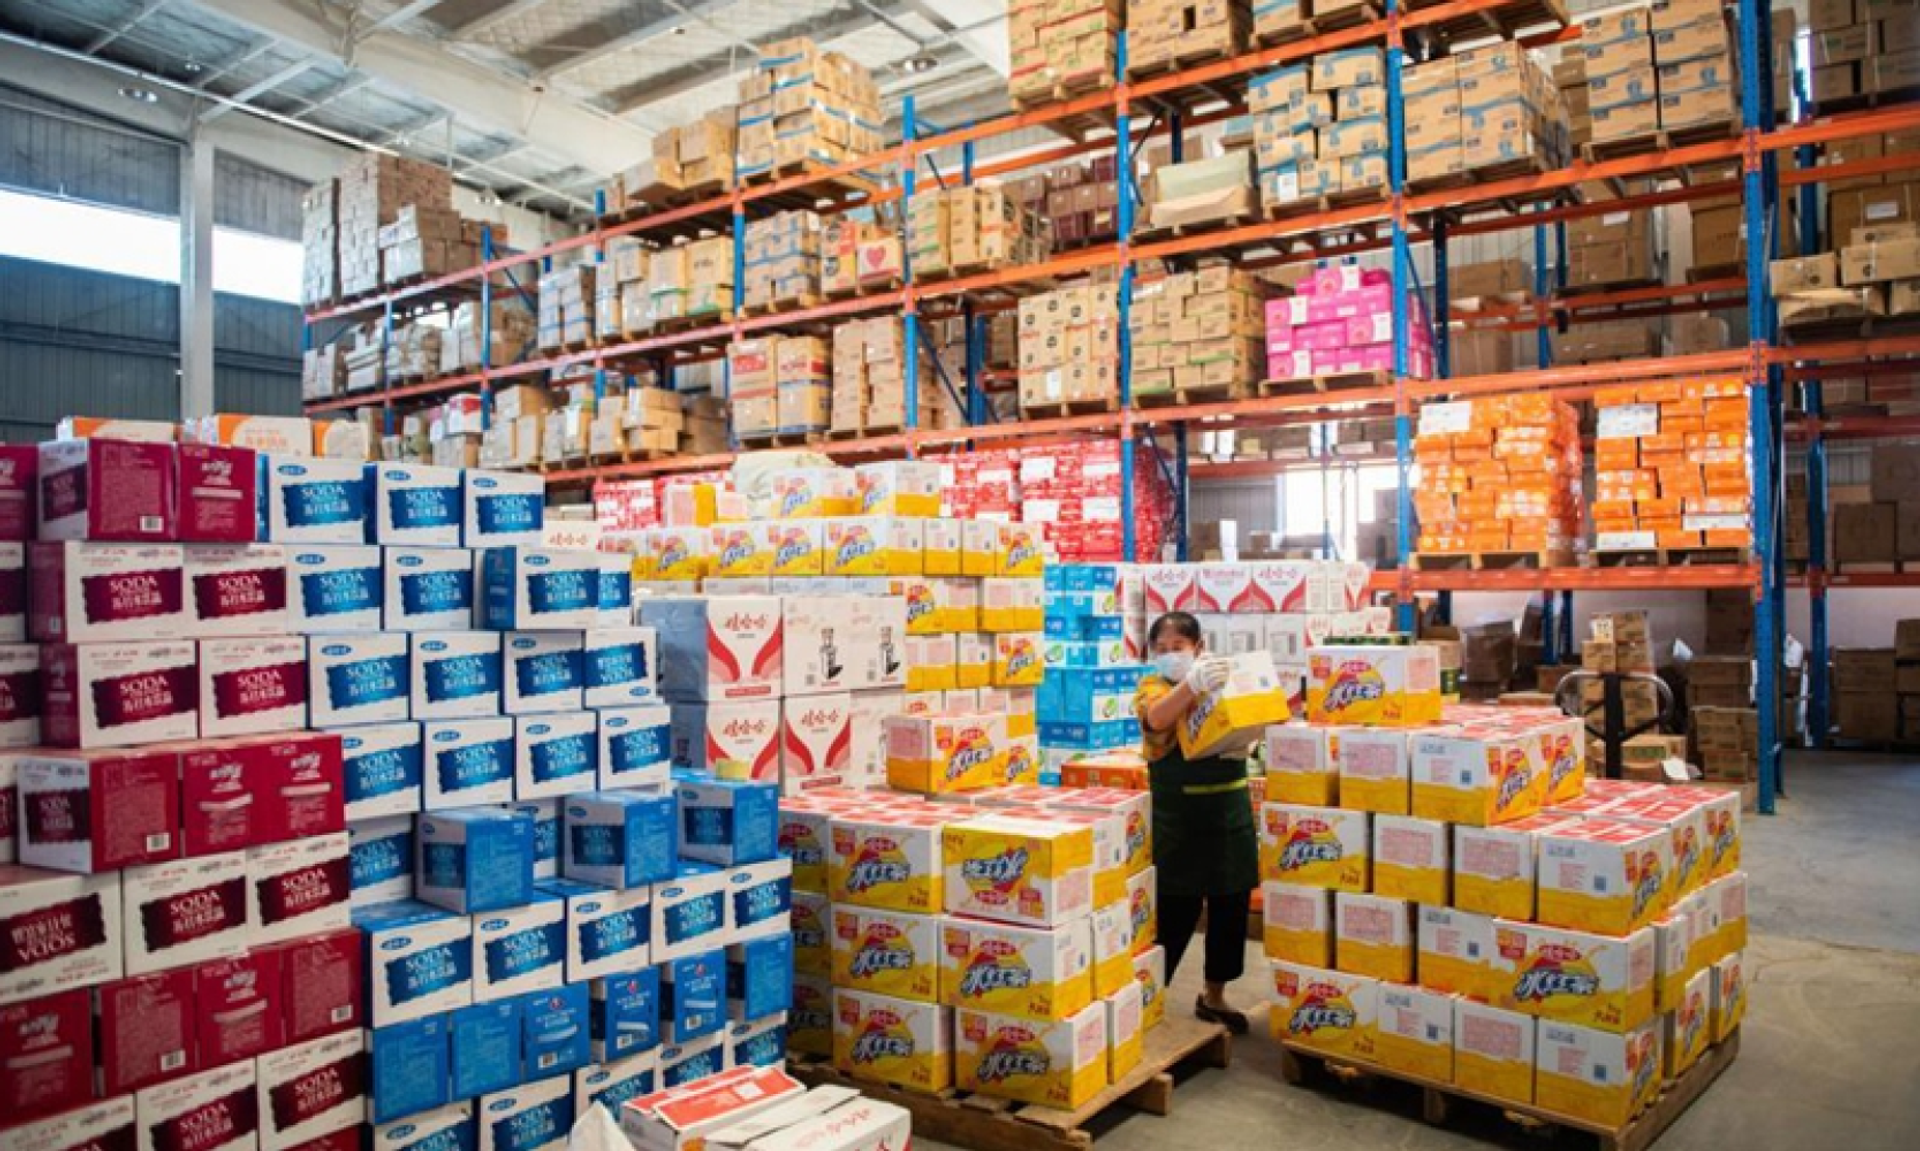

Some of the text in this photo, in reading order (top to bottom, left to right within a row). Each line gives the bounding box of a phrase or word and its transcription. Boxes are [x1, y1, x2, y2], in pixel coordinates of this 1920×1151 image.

[109, 575, 158, 592] SODA
[218, 574, 262, 591] SODA
[120, 674, 168, 695] SODA
[238, 669, 281, 687] SODA
[281, 868, 327, 888] SODA
[170, 890, 220, 916] SODA
[295, 1067, 339, 1096] SODA
[179, 1102, 229, 1132] SODA
